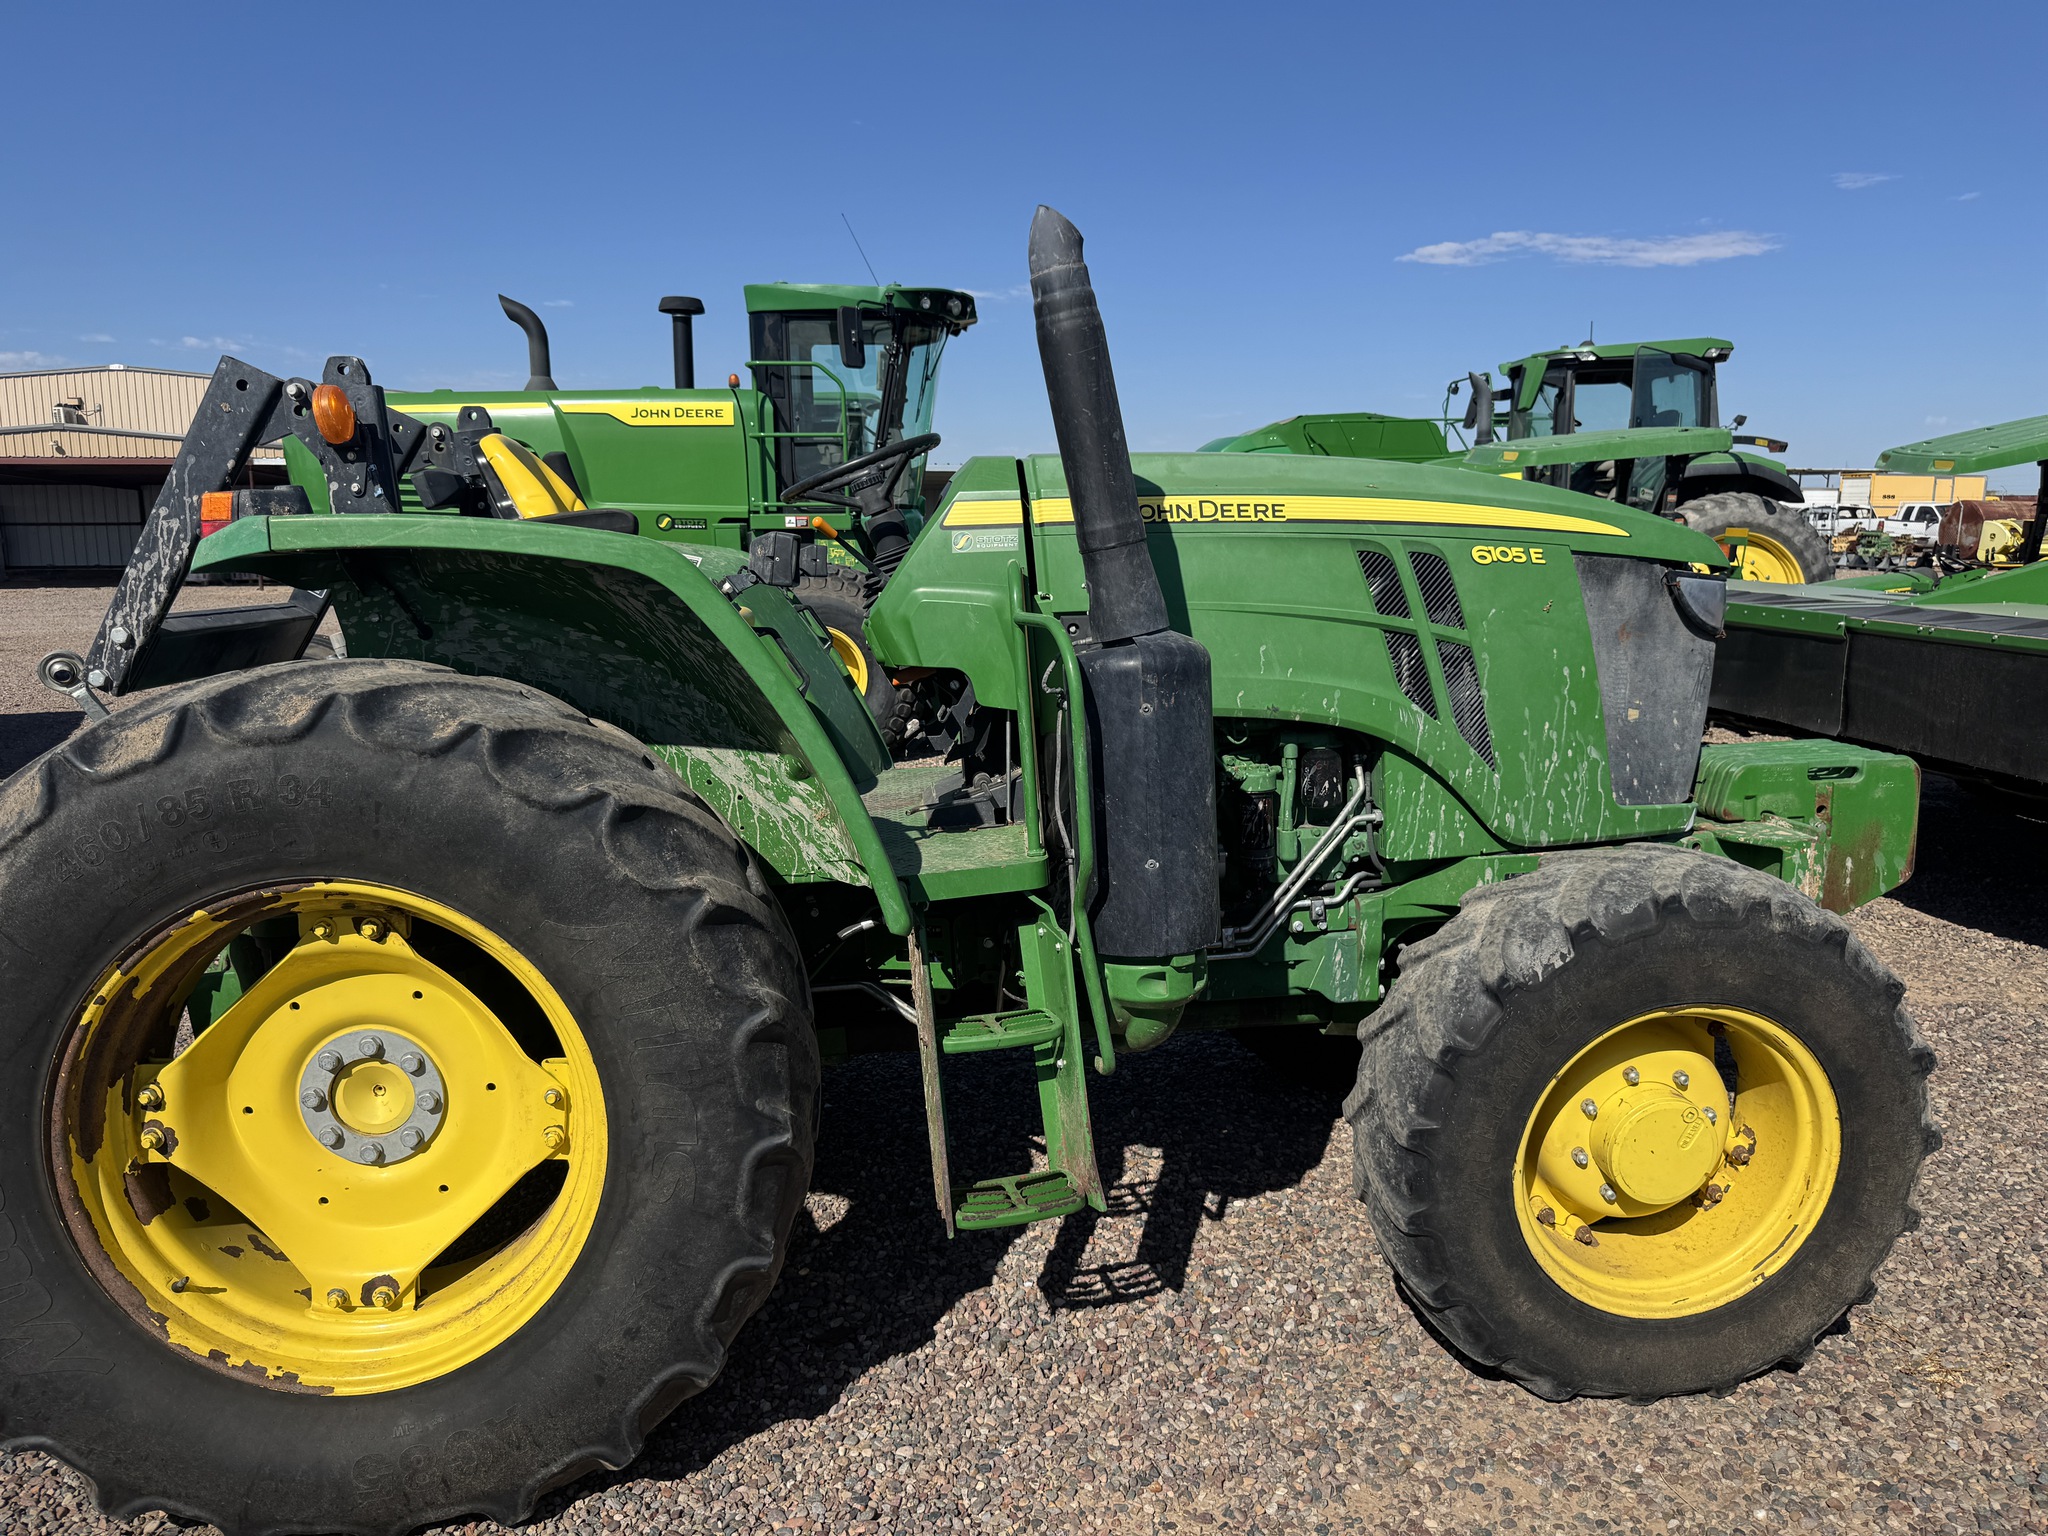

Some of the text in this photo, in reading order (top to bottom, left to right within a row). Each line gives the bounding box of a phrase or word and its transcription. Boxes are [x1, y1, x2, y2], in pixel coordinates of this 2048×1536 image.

[631, 407, 724, 418] JOHN DEERE
[1139, 500, 1286, 519] OHN DEERE
[976, 534, 1019, 544] STOTZ
[1471, 545, 1547, 565] 6105 E
[226, 778, 263, 813] R
[277, 773, 335, 809] 34
[1463, 1000, 1580, 1200] ALLIANCE
[1686, 1120, 1702, 1140] LEVEL
